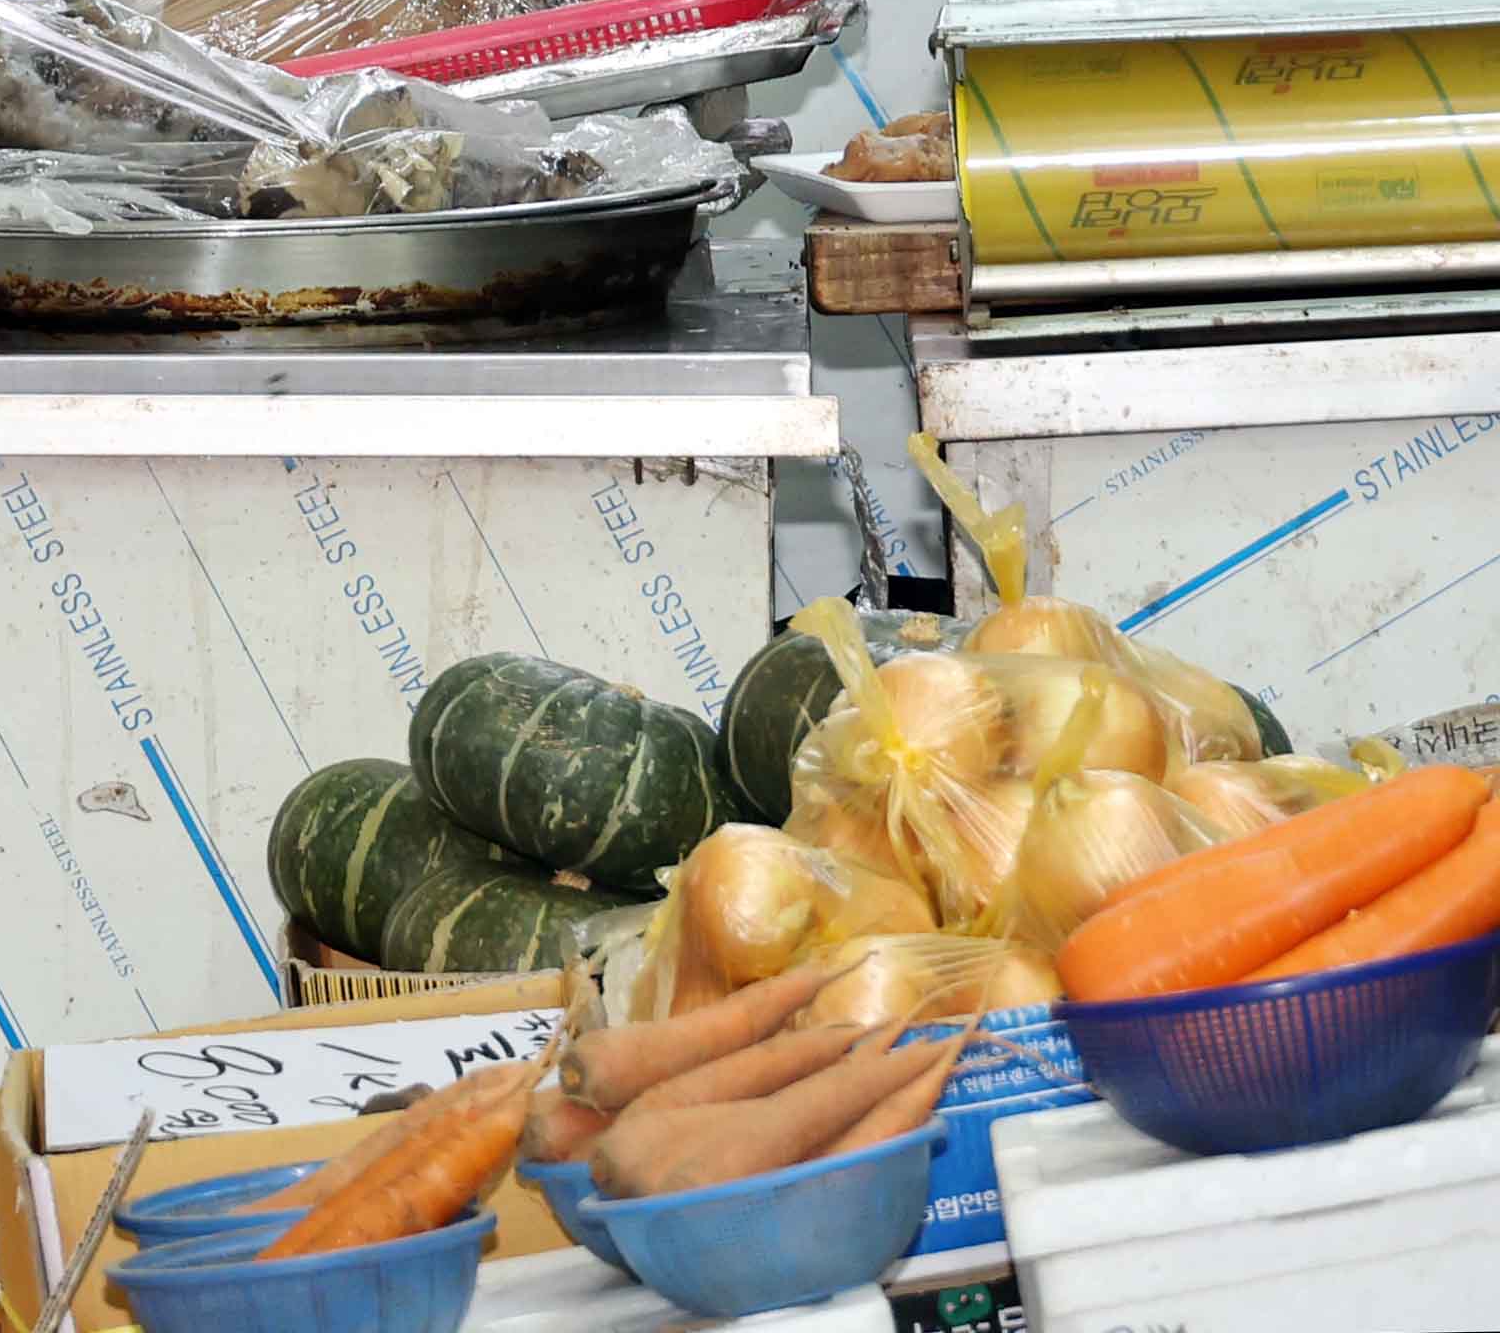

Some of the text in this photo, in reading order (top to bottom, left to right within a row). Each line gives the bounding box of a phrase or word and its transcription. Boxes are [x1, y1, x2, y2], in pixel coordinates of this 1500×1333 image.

[1070, 188, 1218, 237] 모닝랩
[1105, 431, 1206, 496] STAINLESS
[1, 471, 153, 732] STAINLESS STEEL
[295, 474, 430, 714] AINLESS STEEL
[38, 813, 135, 979] STAINLESS STEEL
